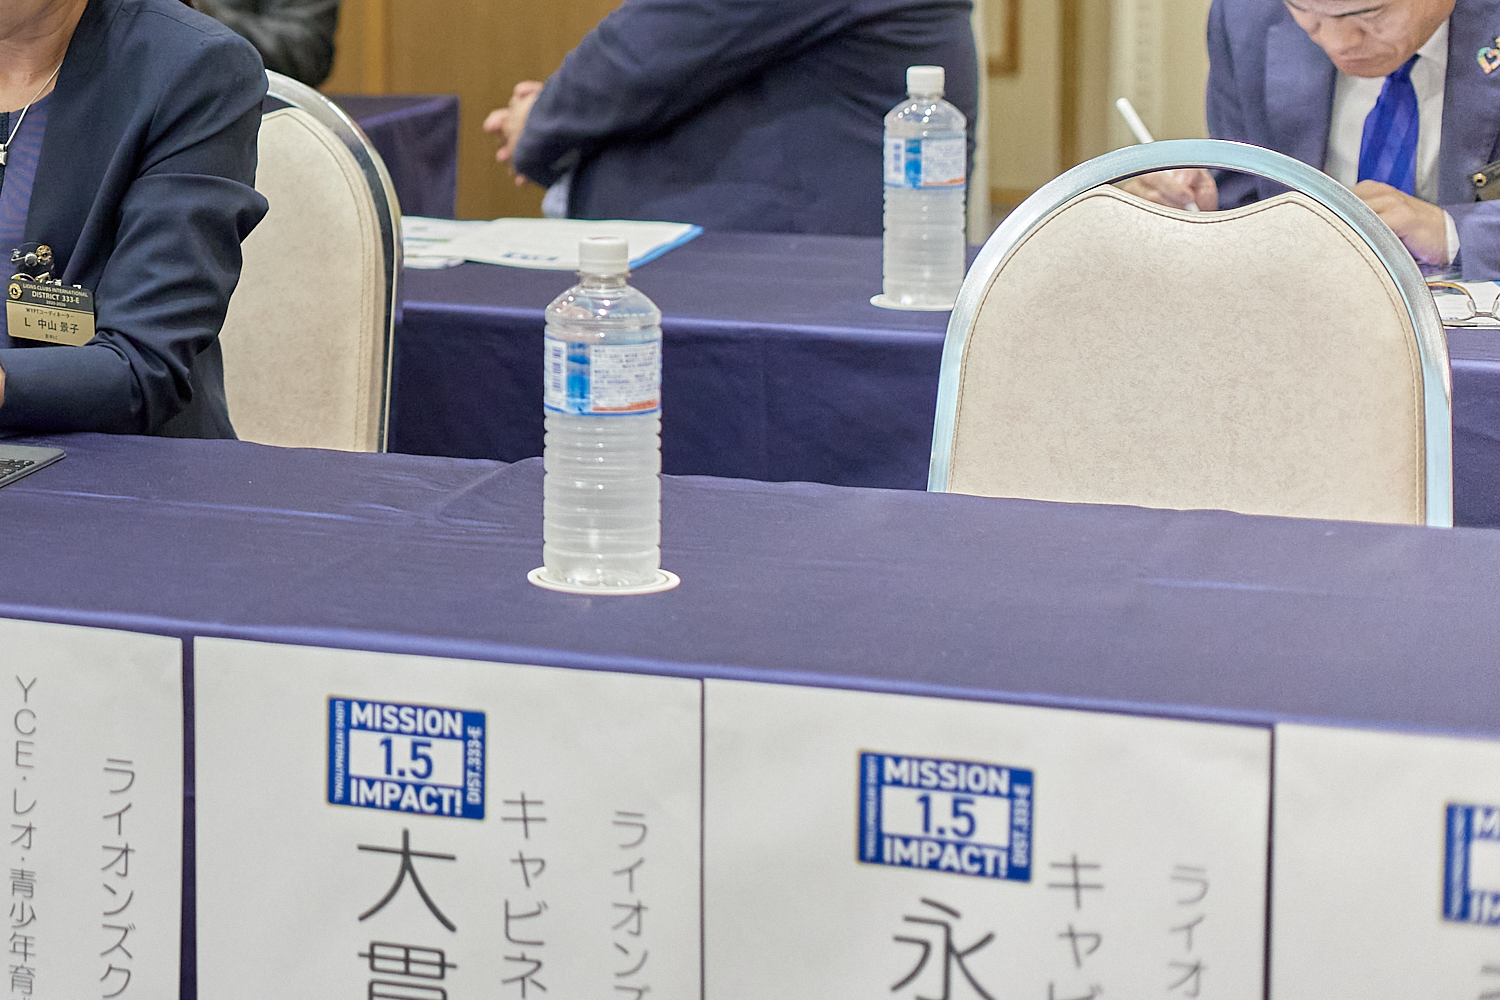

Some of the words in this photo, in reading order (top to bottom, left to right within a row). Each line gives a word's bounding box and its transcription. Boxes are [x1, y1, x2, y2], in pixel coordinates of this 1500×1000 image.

[31, 290, 60, 301] DISTRICT
[62, 294, 80, 304] 333-E
[52, 287, 89, 298] INTERNATIONAL
[25, 317, 31, 327] L
[38, 318, 56, 331] 中山
[351, 701, 463, 737] MISSION
[379, 736, 433, 780] 1.5
[883, 756, 1010, 795] MISSION
[350, 777, 463, 816] IMPACT!
[916, 793, 977, 838] 1.5
[8, 675, 37, 1000] YCE・レオ・青少年育
[882, 836, 1009, 878] IMPACT!
[100, 758, 136, 998] ライオンズク
[501, 792, 548, 999] キャビネ
